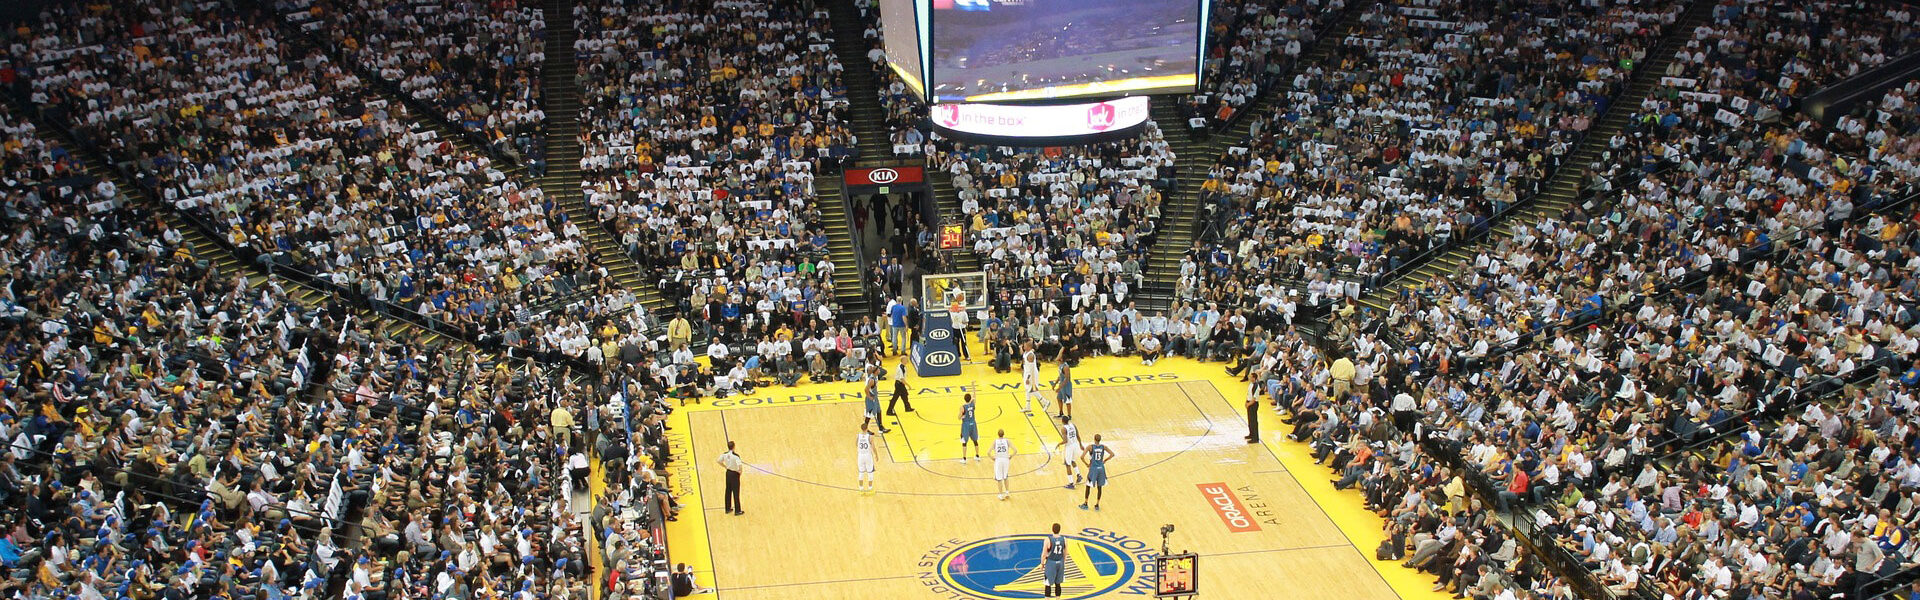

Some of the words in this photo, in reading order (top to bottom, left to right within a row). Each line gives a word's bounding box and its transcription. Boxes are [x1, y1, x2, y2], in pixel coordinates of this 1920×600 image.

[962, 112, 972, 122] in
[974, 113, 995, 125] the
[998, 115, 1024, 126] box
[873, 171, 894, 181] KIA
[943, 234, 960, 247] 24
[932, 330, 947, 338] KIA
[930, 353, 951, 364] KIA
[711, 391, 862, 407] GOLDEN
[876, 381, 979, 398] SATE
[990, 372, 1179, 391] WRIORS
[968, 410, 973, 418] 9
[859, 442, 869, 450] 30
[1094, 453, 1102, 461] 13
[677, 466, 695, 496] Samsung
[1205, 486, 1250, 528] ORACLE
[1237, 485, 1282, 526] ARENA
[918, 538, 966, 568] STATE
[1053, 545, 1062, 555] 42
